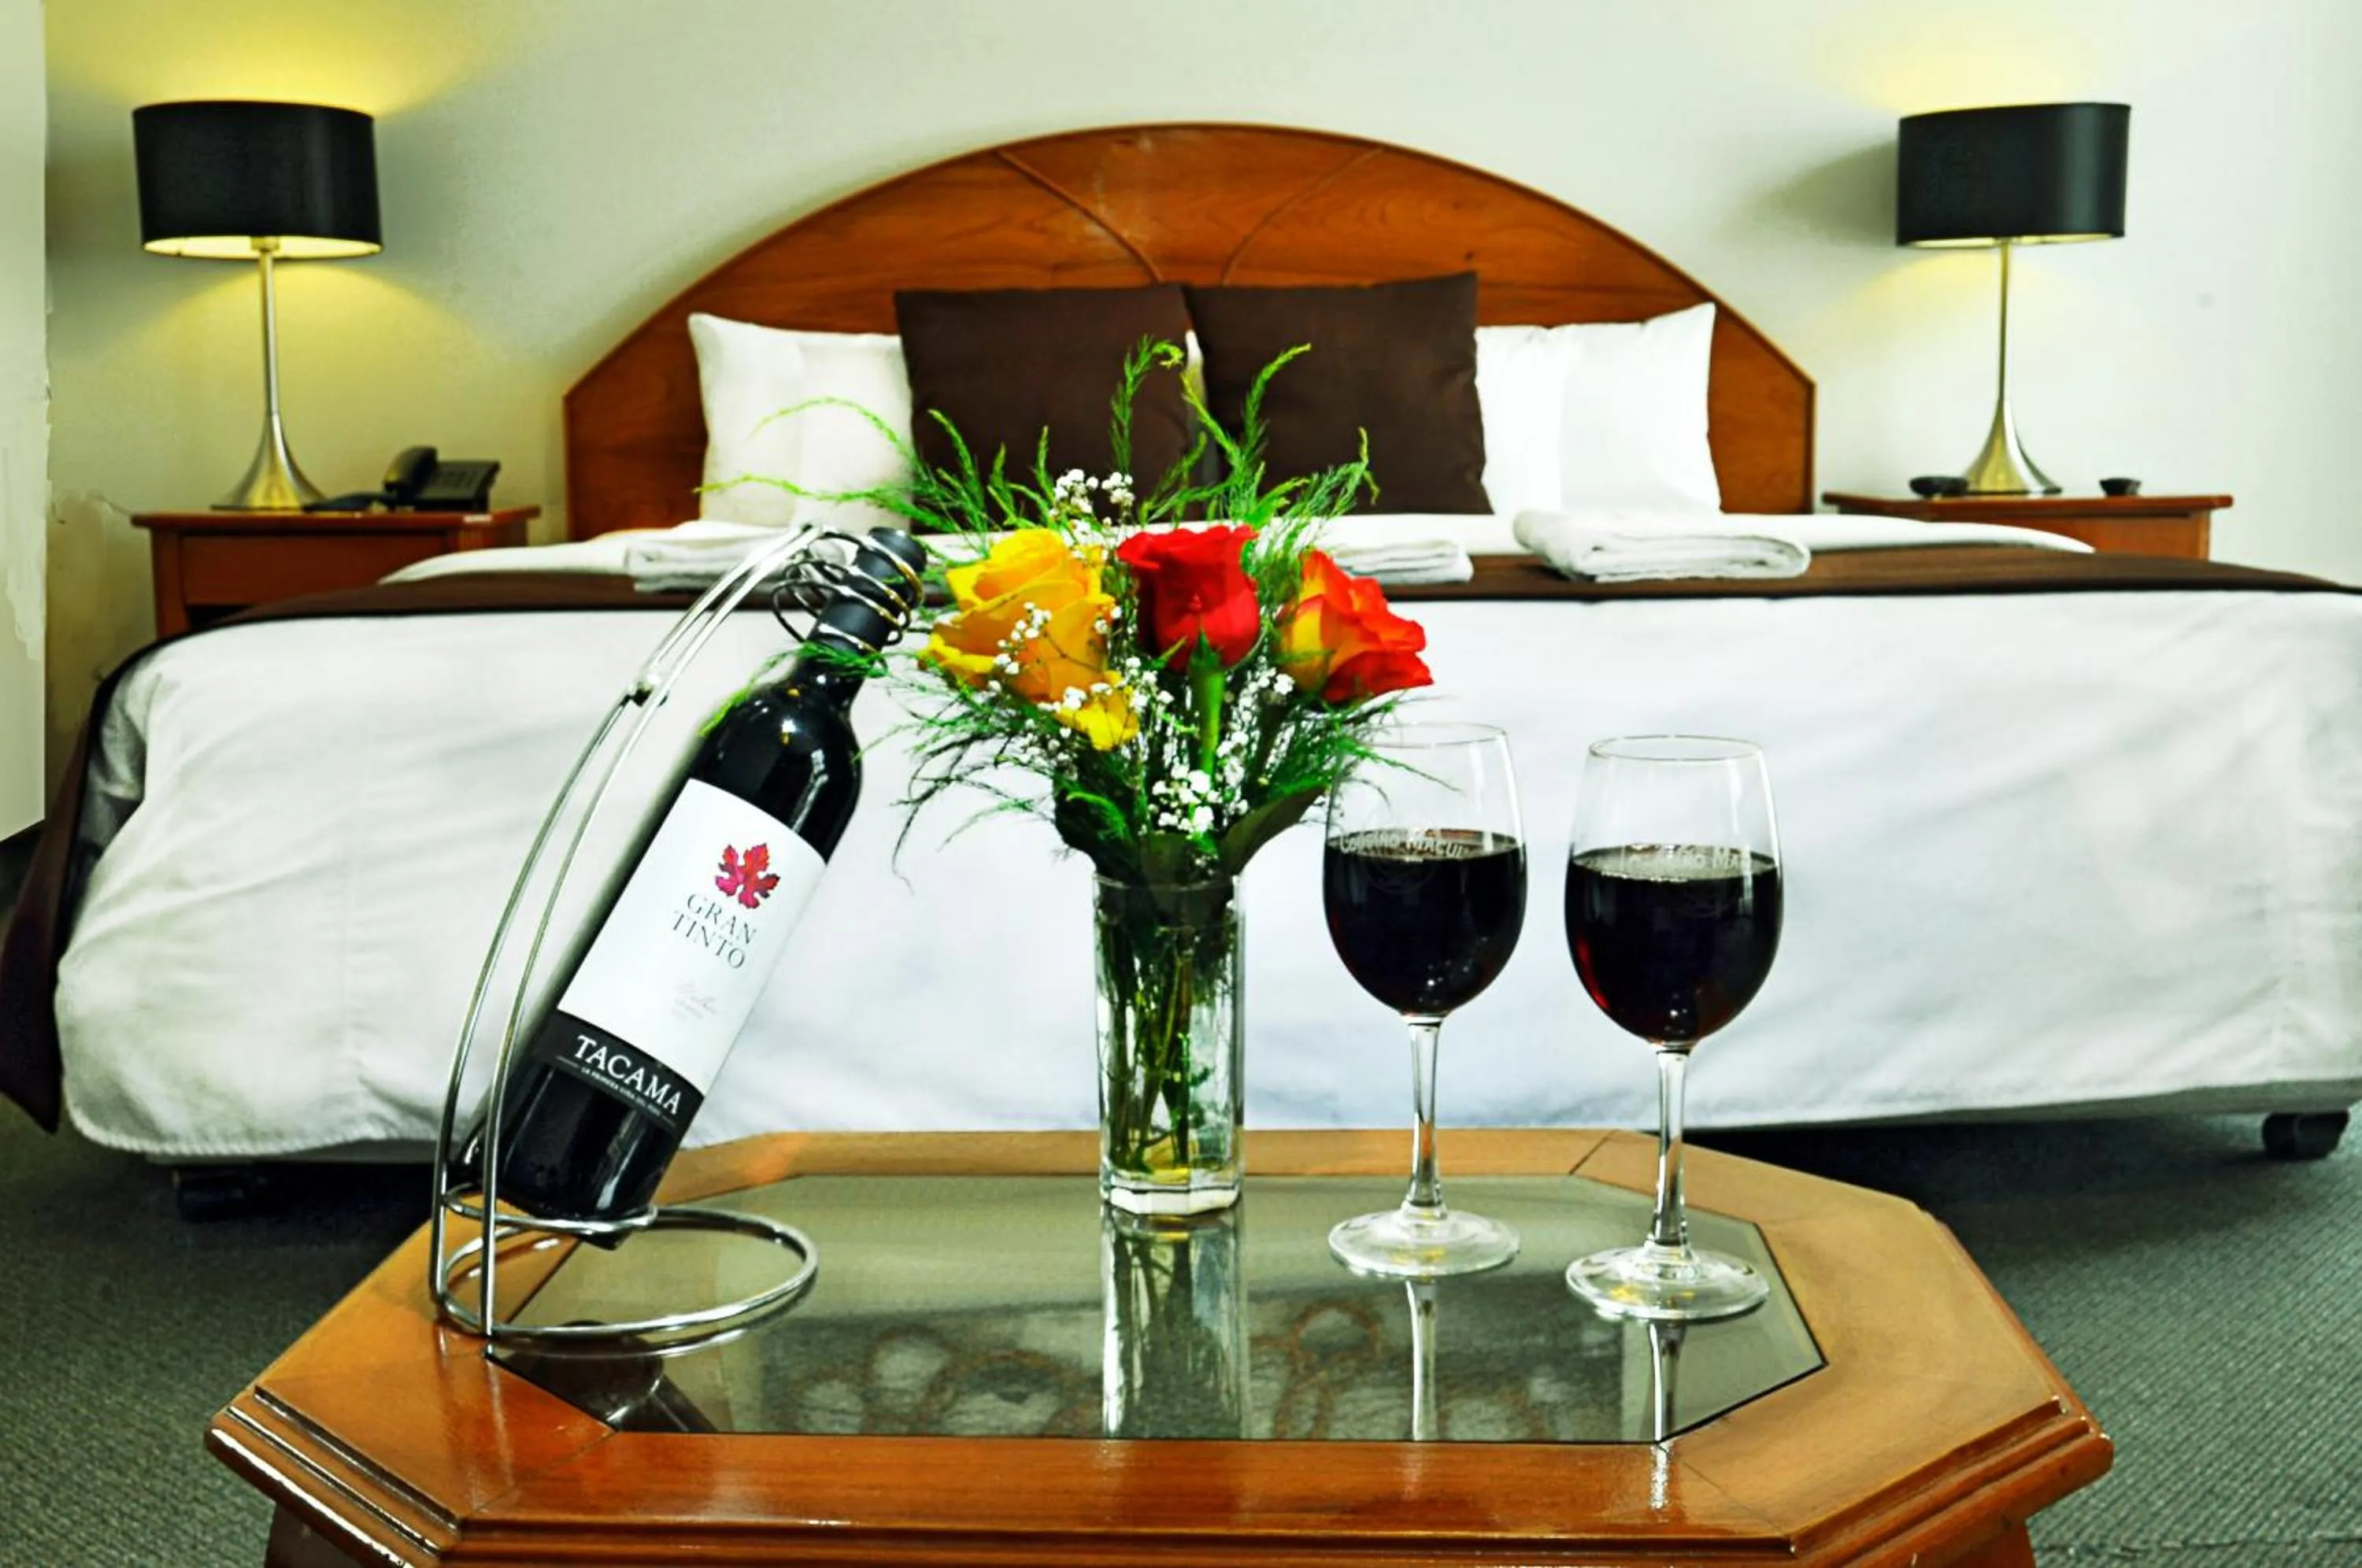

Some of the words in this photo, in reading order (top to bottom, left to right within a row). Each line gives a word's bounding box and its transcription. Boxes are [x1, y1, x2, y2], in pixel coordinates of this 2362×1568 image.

[673, 910, 746, 969] TINTO
[687, 893, 757, 945] GRAN
[575, 1034, 682, 1115] TACAMA
